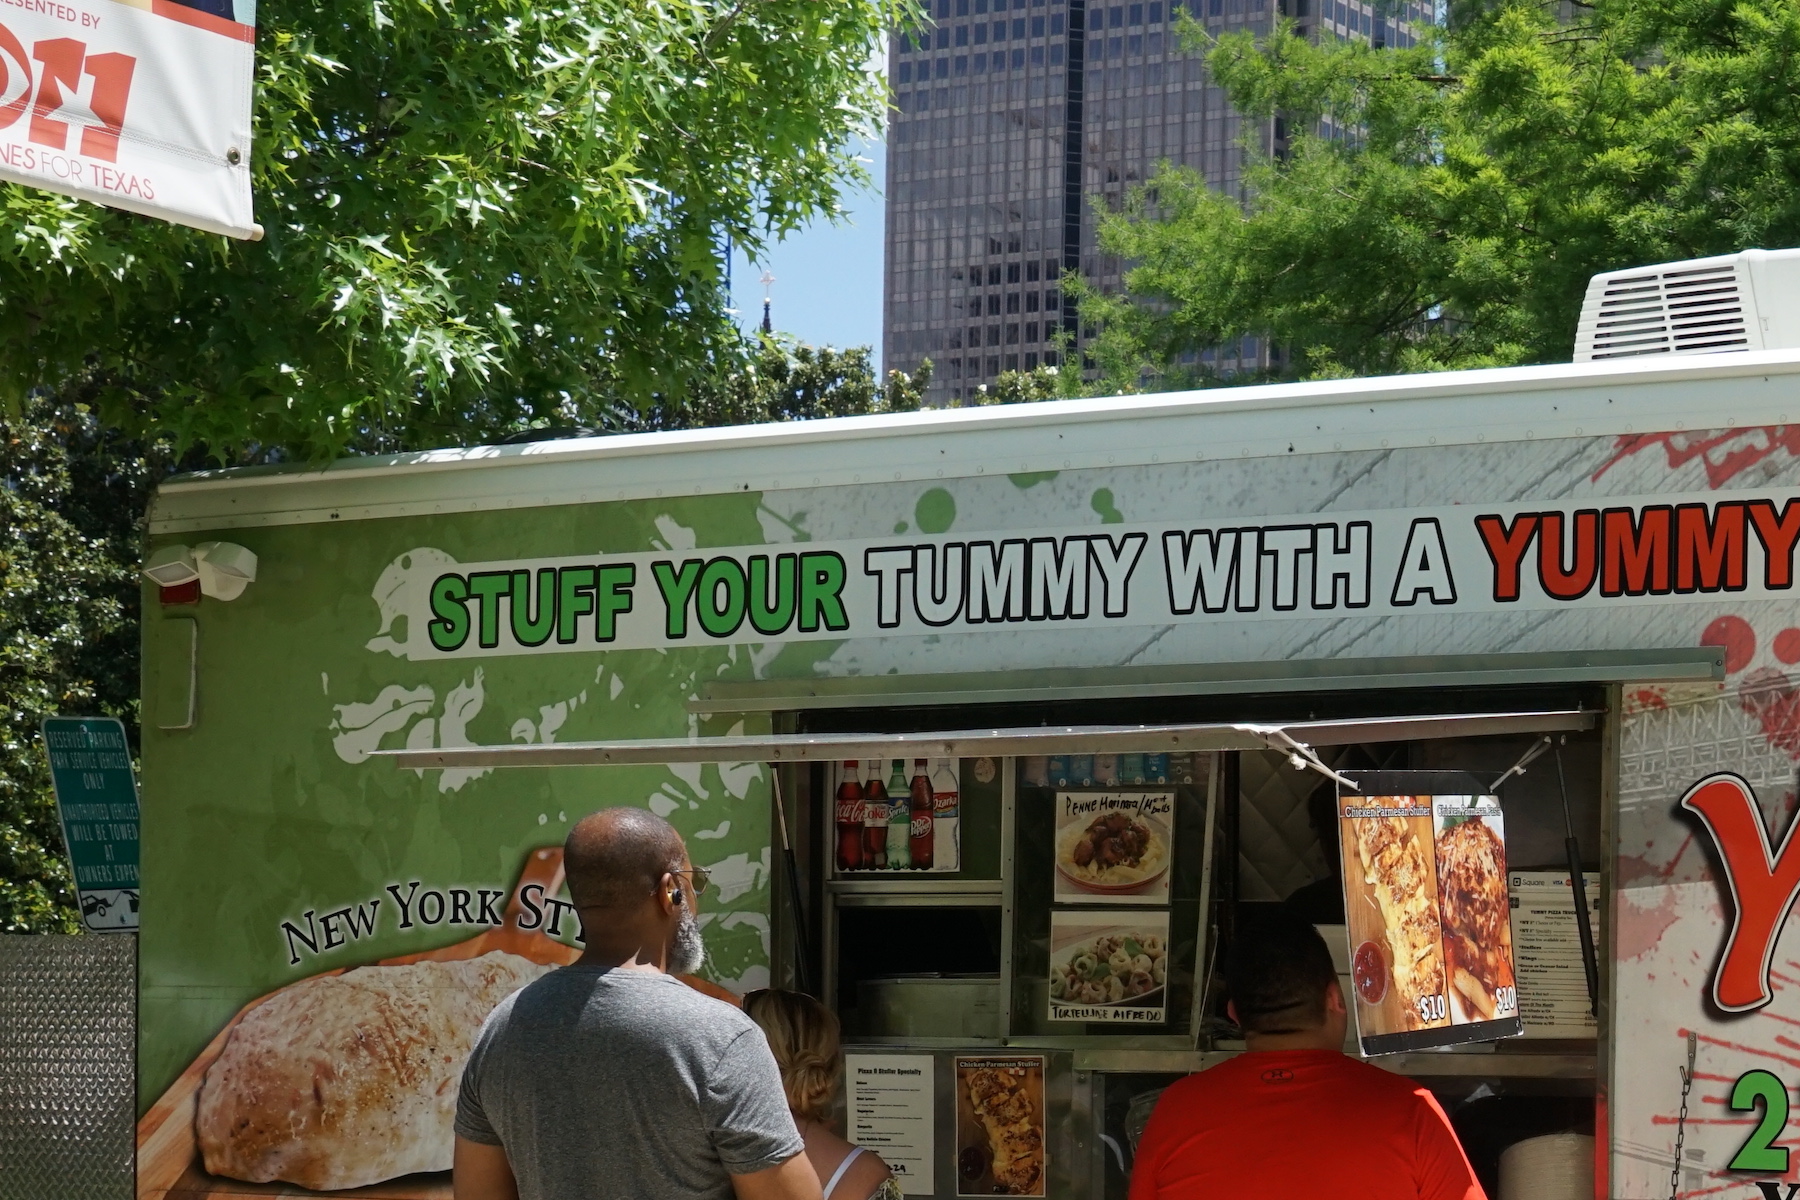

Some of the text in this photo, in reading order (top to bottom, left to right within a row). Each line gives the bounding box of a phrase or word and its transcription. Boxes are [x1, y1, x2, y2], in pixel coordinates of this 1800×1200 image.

[81, 12, 101, 30] BY
[40, 151, 82, 183] FOR
[89, 163, 155, 200] TEXAS
[427, 562, 637, 652] STUFF
[650, 551, 850, 640] YOUR
[864, 531, 1148, 627] TUMMY
[1162, 520, 1372, 616] WITH
[1391, 517, 1457, 607] A
[48, 731, 123, 749] RESERVED PARKING
[51, 752, 129, 769] PARK SERVICE VEHICLES
[83, 773, 106, 790] ONLY
[61, 803, 139, 820] UNAUTHORIZED VEHICLES
[1345, 805, 1431, 818] Chicken Parmesan Stuffer
[1437, 804, 1461, 817] Chicken
[1461, 804, 1487, 817] Parmesan
[71, 824, 138, 842] WILL BE TOWED
[104, 845, 115, 862] AT
[77, 866, 113, 883] OWNERS
[1522, 878, 1545, 886] Square
[280, 898, 382, 966] NEW
[386, 881, 505, 930] YORK
[1495, 985, 1516, 1014] $10
[1420, 994, 1446, 1024] $10
[1017, 1060, 1040, 1068] Stuffer
